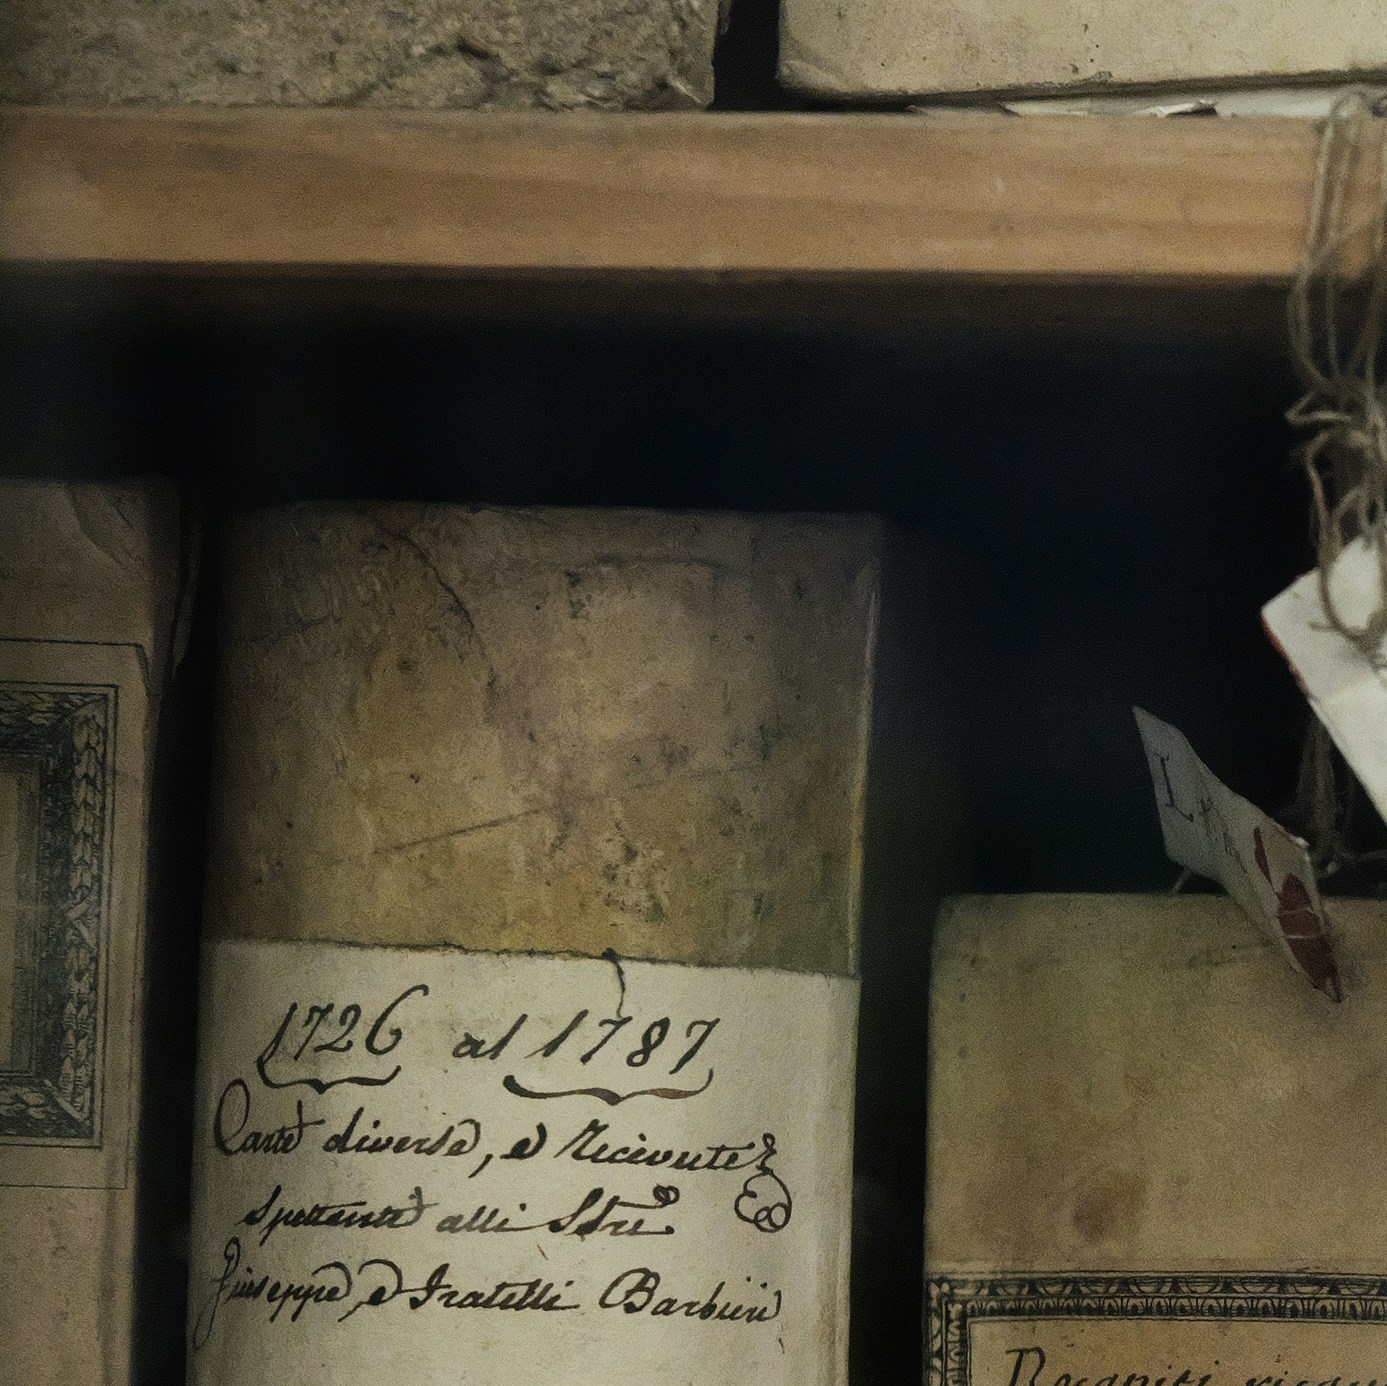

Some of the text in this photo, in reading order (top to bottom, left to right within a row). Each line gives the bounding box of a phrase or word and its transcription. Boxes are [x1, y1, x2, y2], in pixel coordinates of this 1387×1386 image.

[257, 985, 720, 1075] 1726 al 1787
